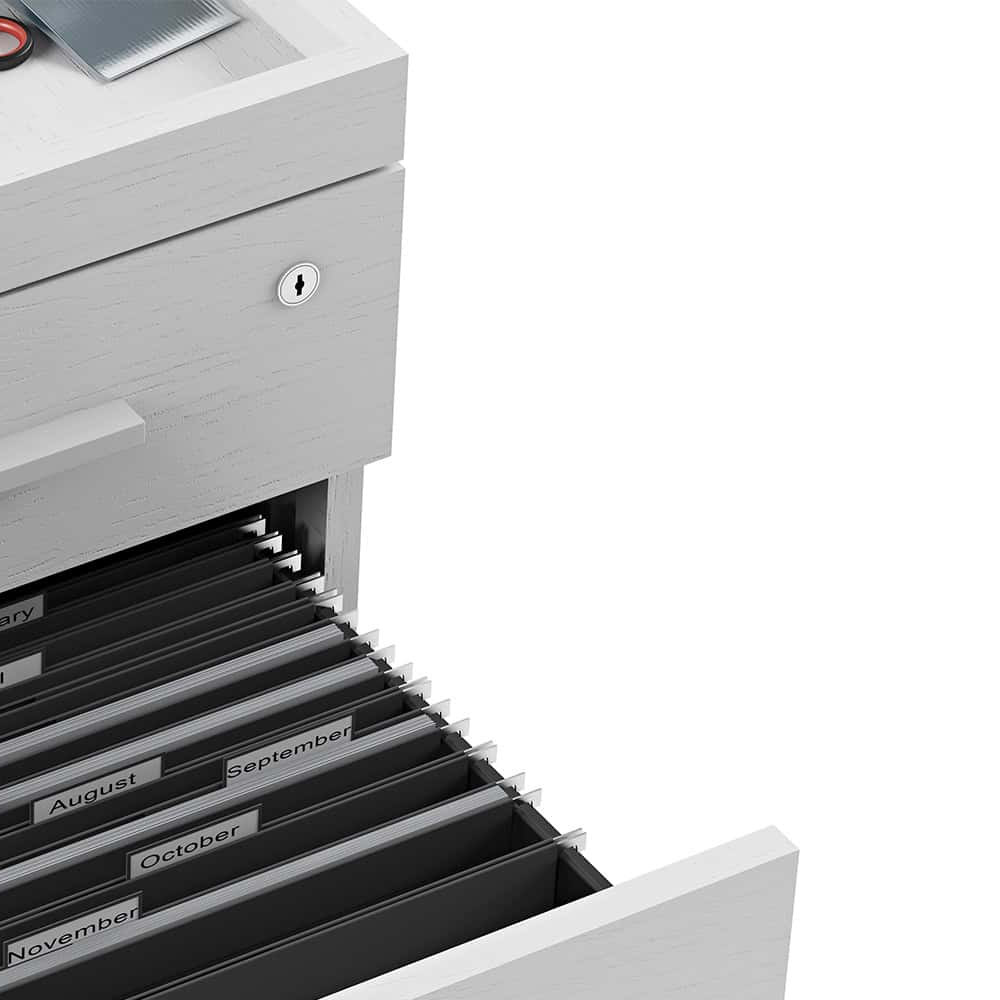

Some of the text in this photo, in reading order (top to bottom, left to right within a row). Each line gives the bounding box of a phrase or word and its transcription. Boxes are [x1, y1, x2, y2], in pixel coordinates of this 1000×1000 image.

[227, 725, 352, 780] September
[48, 772, 137, 816] August
[140, 823, 240, 870] October
[7, 905, 139, 965] November
